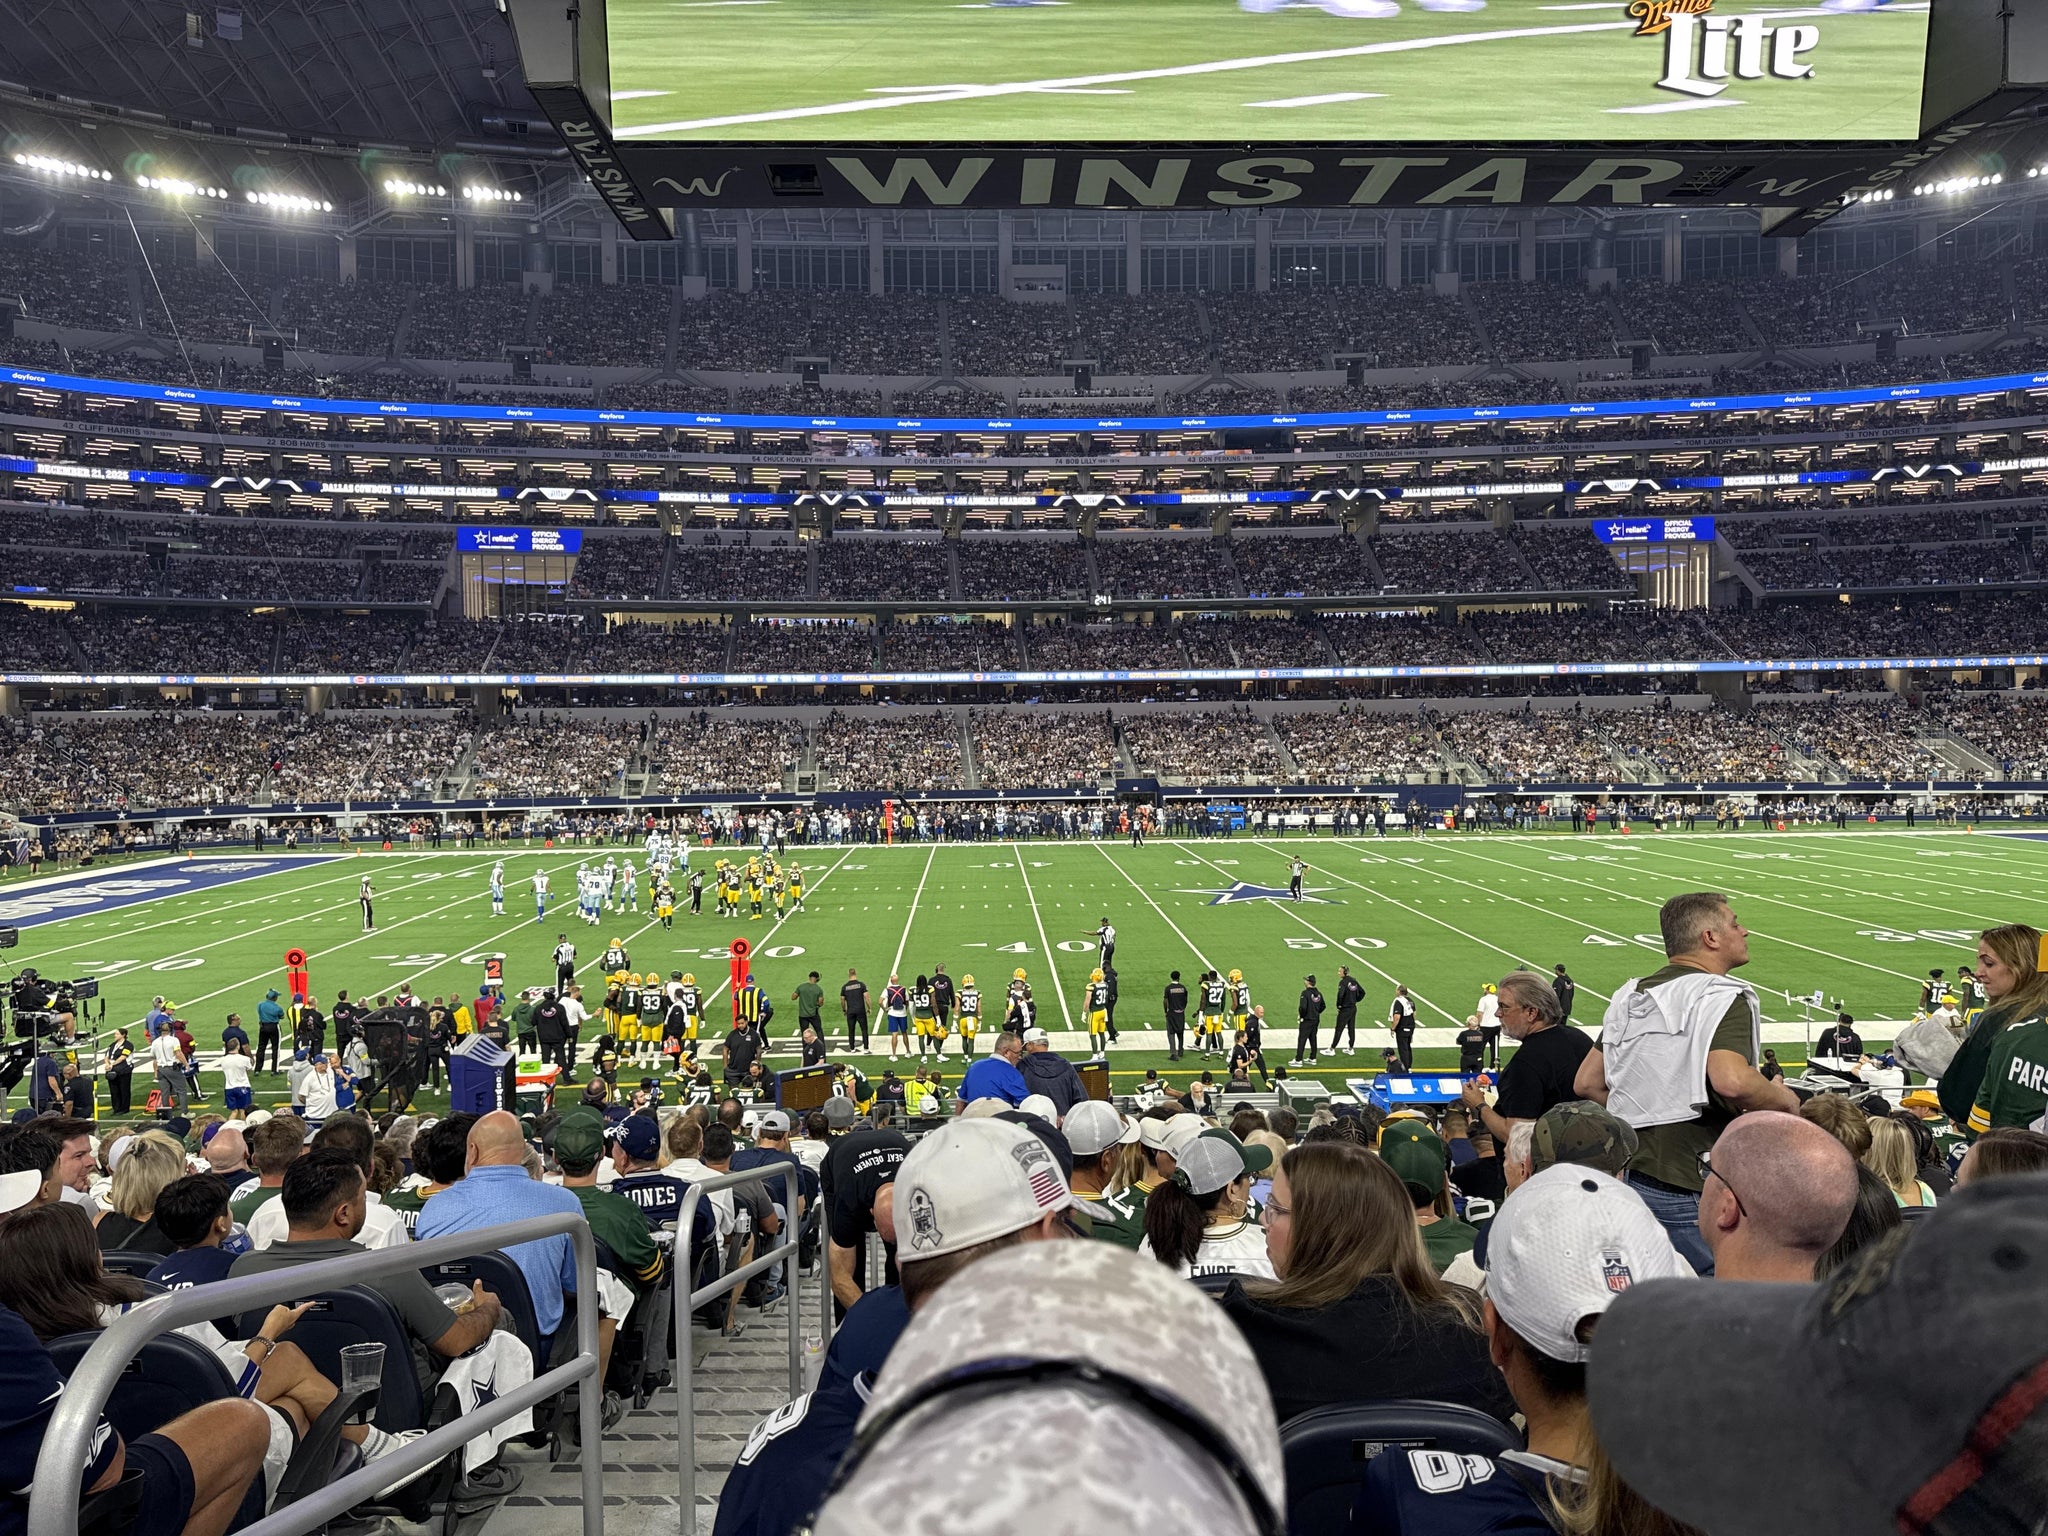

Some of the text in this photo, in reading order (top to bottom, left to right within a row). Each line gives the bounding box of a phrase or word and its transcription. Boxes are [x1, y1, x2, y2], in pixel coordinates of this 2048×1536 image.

[1658, 13, 1820, 96] Lite
[560, 120, 650, 222] WINSTAR
[1801, 122, 1986, 220] WINSTR
[827, 157, 1684, 206] WINSTAR
[11, 372, 46, 383] dayforce
[164, 389, 196, 399] dayforce
[1890, 388, 1920, 397] dayforce
[271, 398, 302, 407] dayforce
[1783, 395, 1812, 404] dayforce
[379, 404, 408, 413] dayforce
[1689, 400, 1716, 409] dayforce
[506, 409, 533, 417] dayforce
[1473, 409, 1499, 417] dayforce
[1569, 405, 1595, 414] dayforce
[598, 412, 625, 420] dayforce
[695, 415, 722, 423] dayforce
[1272, 416, 1297, 424] dayforce
[1385, 412, 1411, 420] dayforce
[811, 419, 837, 427] dayforce
[896, 420, 922, 428] dayforce
[987, 420, 1012, 428] dayforce
[1098, 420, 1122, 428] dayforce
[1181, 418, 1206, 426] dayforce
[79, 423, 104, 432] CLIFF
[108, 426, 141, 435] HARRIS
[1858, 430, 1880, 438] TONY
[1882, 427, 1921, 437] DORSETT
[280, 439, 298, 447] BOB
[1703, 438, 1732, 446] LANDRY
[1513, 445, 1526, 453] LEE
[630, 452, 657, 460] RENFRO
[1369, 450, 1402, 458] STAUBACH
[1214, 455, 1241, 463] PERKINS
[1982, 459, 2019, 472] DALLAS
[37, 463, 91, 478] DECEMBER
[106, 470, 129, 480] 2025
[1723, 475, 1766, 486] DECEMBER
[1779, 474, 1798, 484] 2025
[321, 483, 354, 493] DALLAS
[355, 484, 392, 494] COWBOYS
[403, 485, 418, 494] LOS
[419, 486, 454, 495] ANGELES
[455, 487, 498, 497] CHARGERS
[1401, 488, 1430, 498] DALLAS
[1431, 487, 1465, 497] COWBOYS
[1475, 486, 1490, 496] LOS
[884, 496, 911, 505] DALLAS
[912, 496, 944, 505] COWBOYS
[607, 951, 623, 965] 94
[487, 961, 501, 977] 2
[628, 992, 634, 1007] 1
[1095, 989, 1106, 1005] 31
[1208, 988, 1224, 1003] 27
[642, 995, 661, 1010] 93
[913, 994, 929, 1008] 59
[961, 996, 978, 1012] 39
[853, 1153, 904, 1174] SEAT DELIVERY
[624, 1185, 676, 1207] JONES
[1609, 1276, 1629, 1289] NFL
